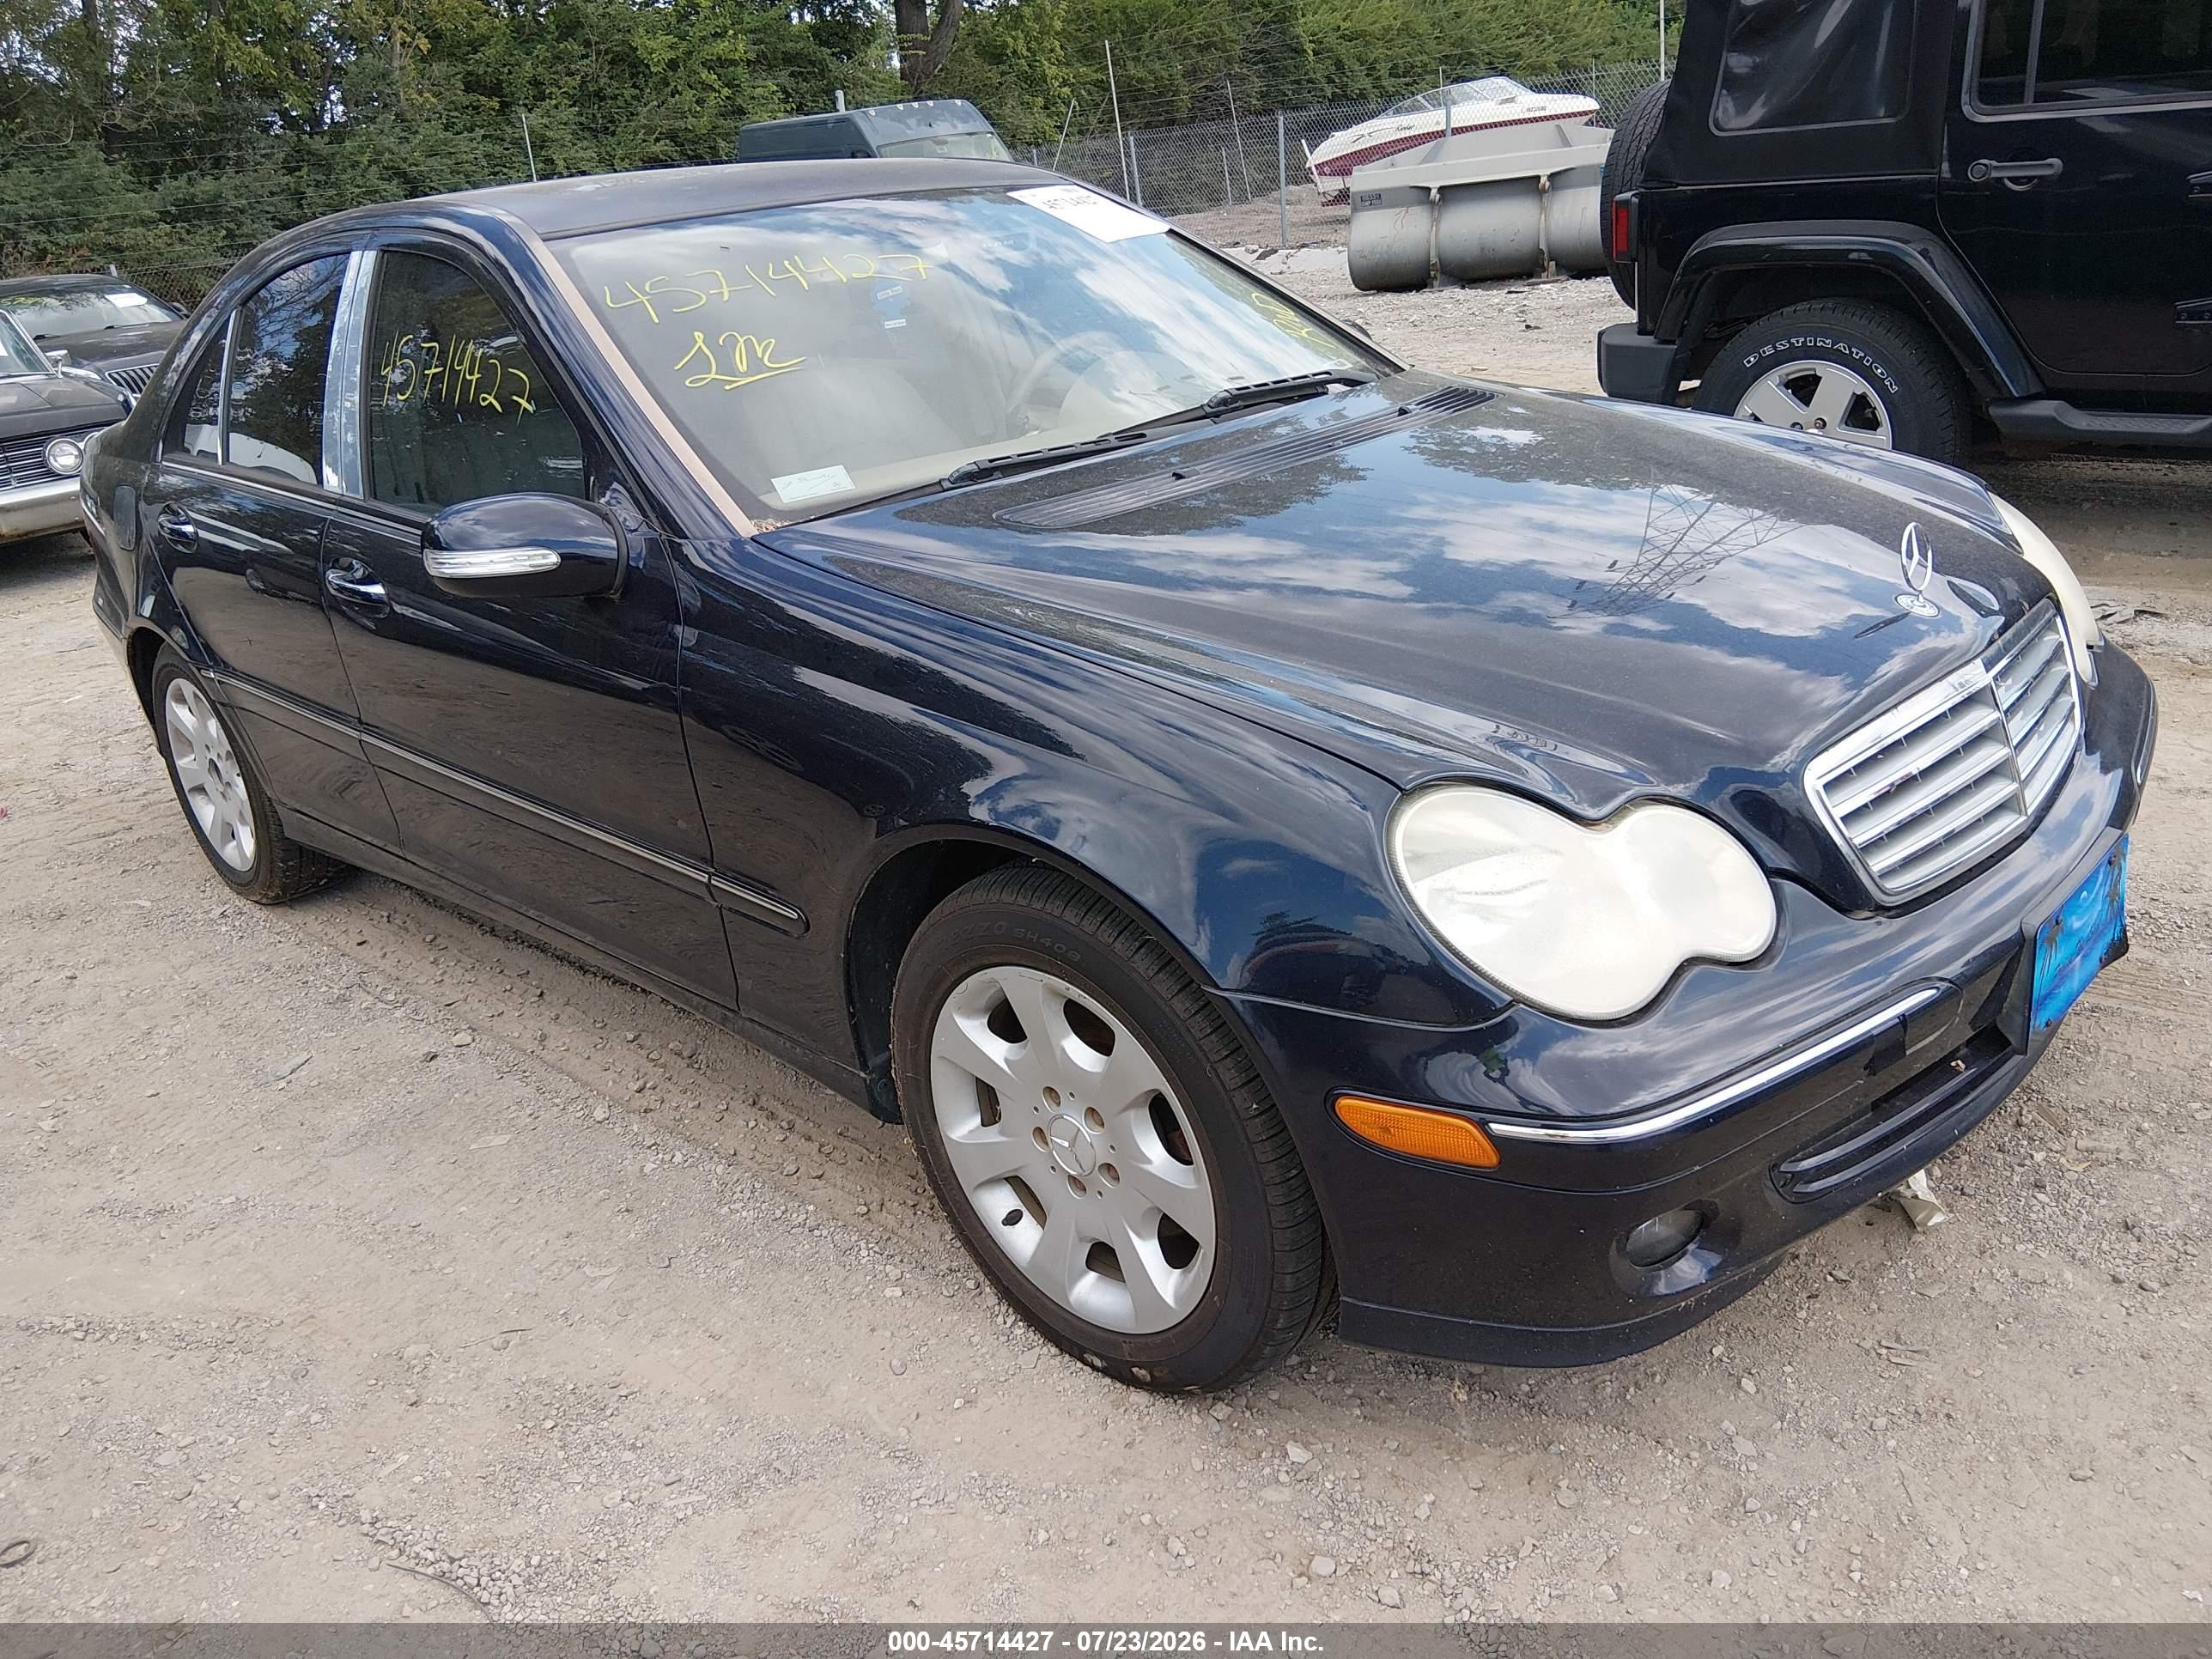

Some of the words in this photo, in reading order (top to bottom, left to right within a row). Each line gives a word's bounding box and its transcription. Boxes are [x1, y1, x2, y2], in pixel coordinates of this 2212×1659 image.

[604, 253, 935, 324] 45714427
[380, 330, 536, 427] 45714427
[1743, 337, 1898, 394] DESTINATION
